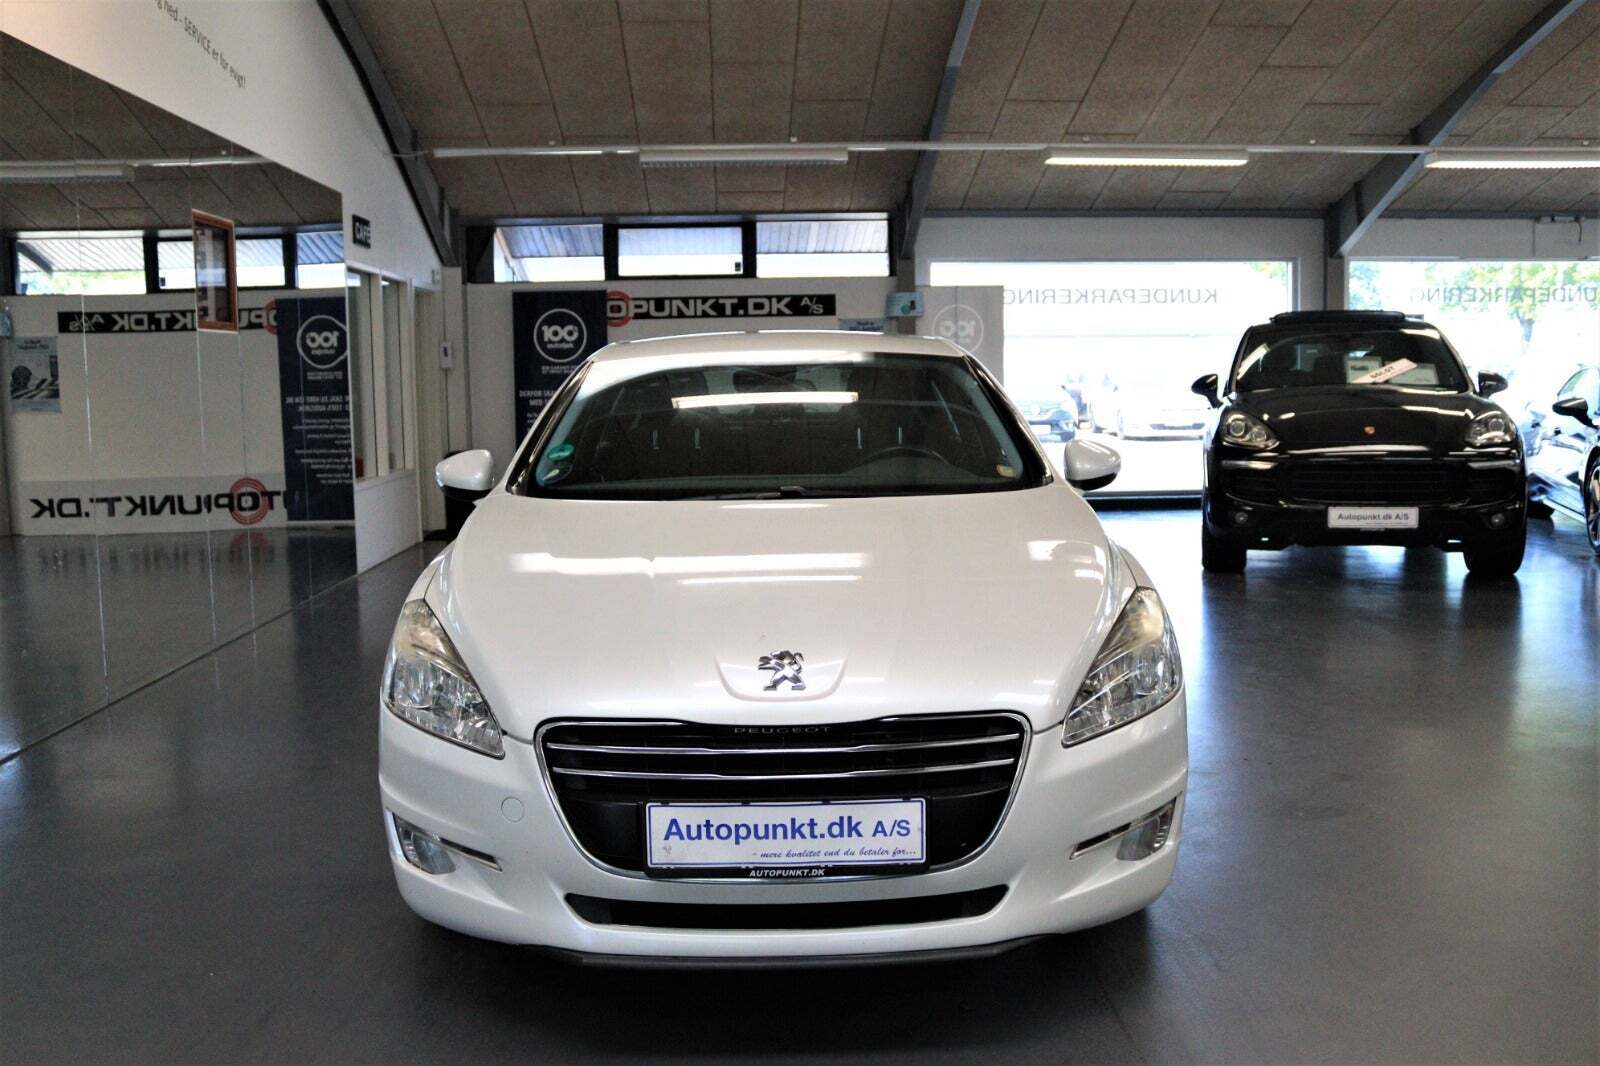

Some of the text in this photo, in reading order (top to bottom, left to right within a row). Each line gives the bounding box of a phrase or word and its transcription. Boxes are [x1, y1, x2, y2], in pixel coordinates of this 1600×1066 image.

[184, 16, 211, 55] SERVICE
[801, 296, 824, 314] A/S
[541, 324, 579, 342] 100
[1338, 513, 1409, 521] Autopunkt.dk A/S
[734, 726, 832, 735] PEUGEOT
[664, 816, 911, 845] Autopunkt.dk A/S
[785, 848, 821, 858] kvalitet
[824, 848, 840, 857] end
[843, 847, 856, 856] du
[859, 846, 889, 856] betaler
[749, 868, 826, 877] AUTOPUNKT.DK
